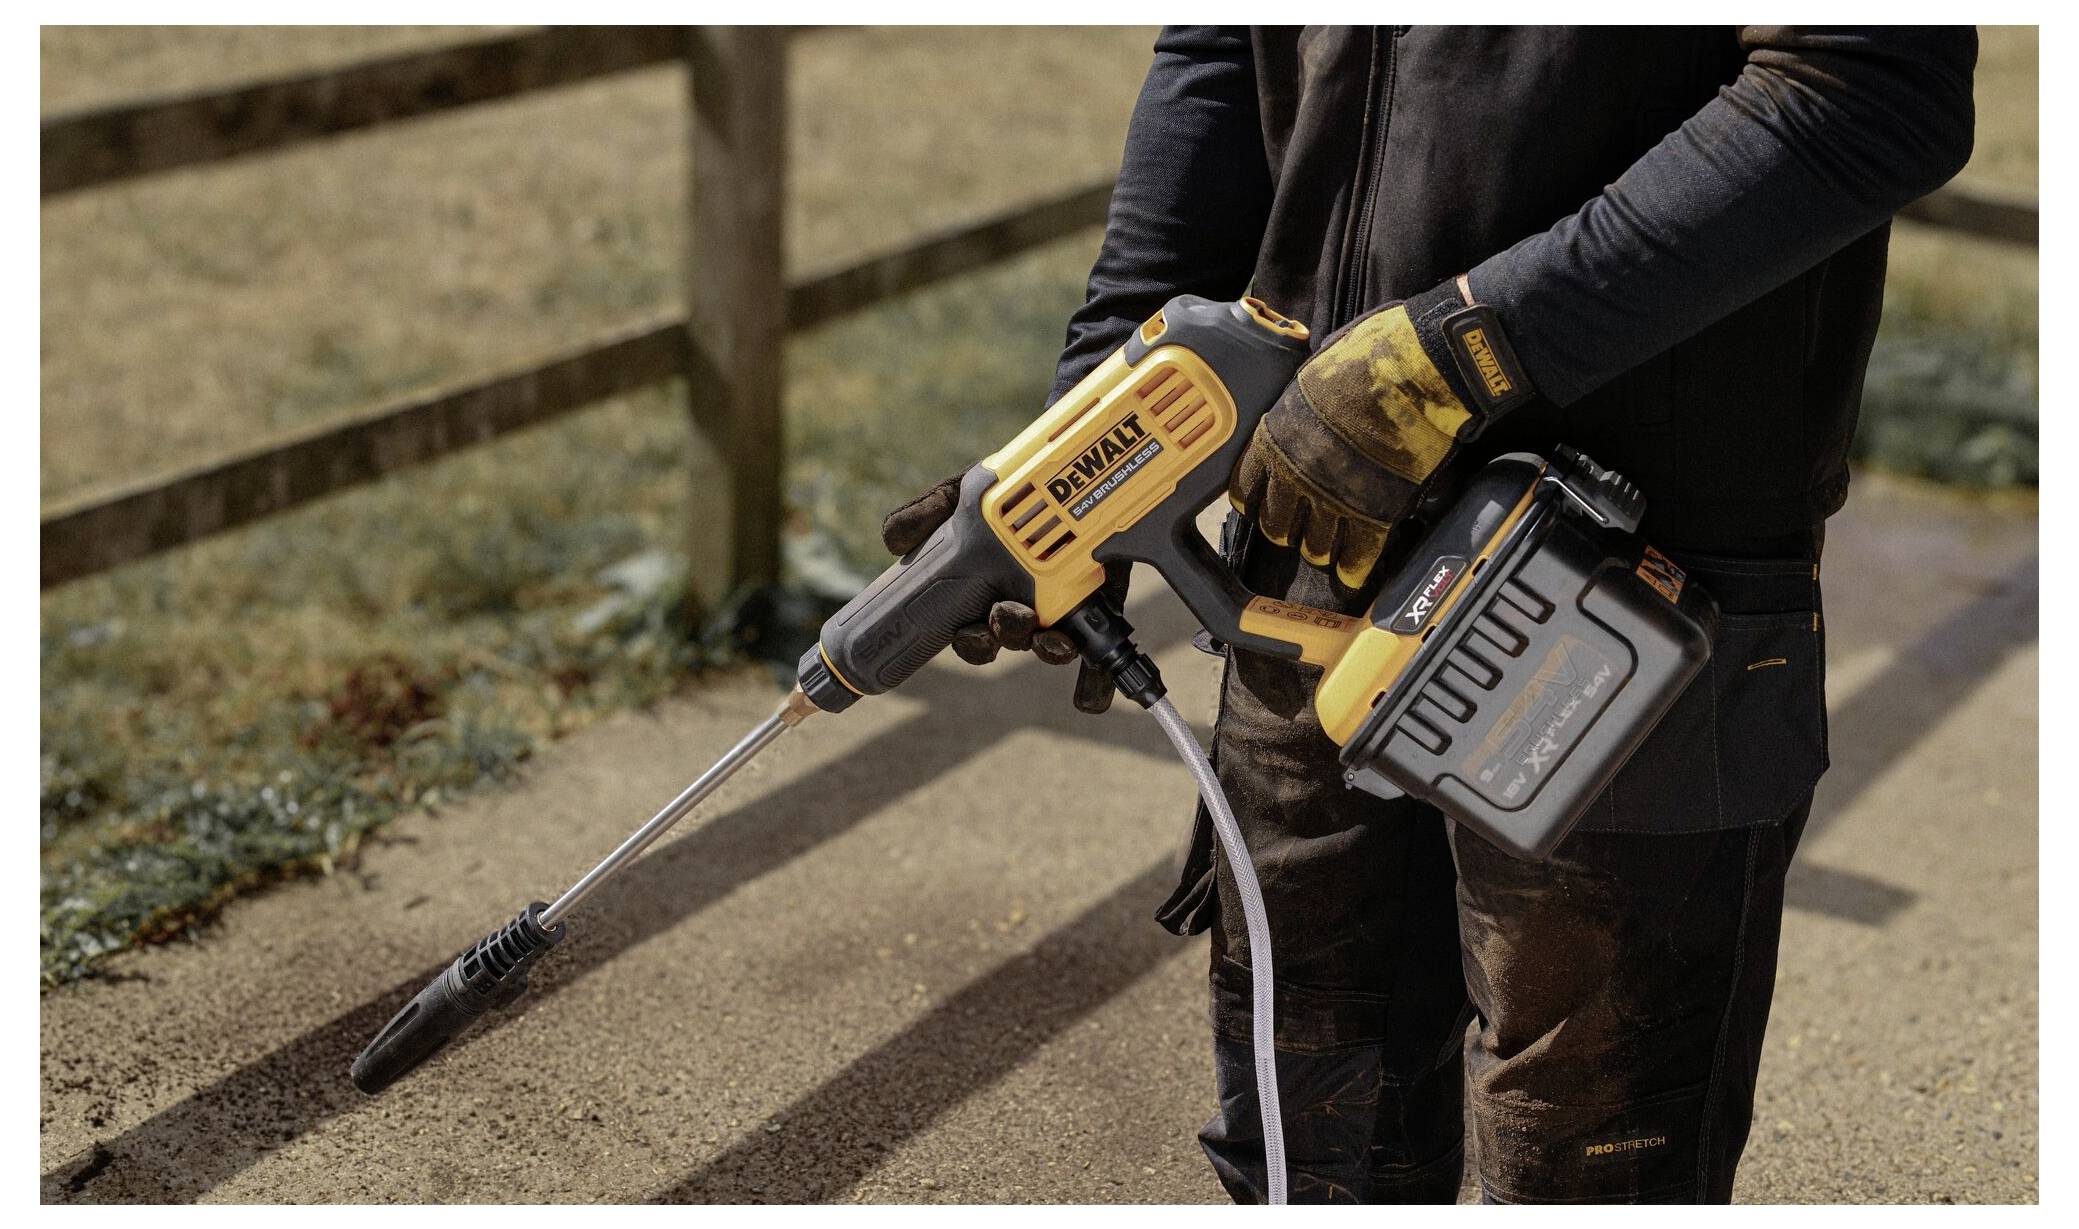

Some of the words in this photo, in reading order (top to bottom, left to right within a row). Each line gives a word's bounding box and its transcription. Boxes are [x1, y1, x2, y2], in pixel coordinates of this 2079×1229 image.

[1072, 497, 1094, 516] 54V
[1093, 441, 1160, 500] BRUSHLESS
[1402, 596, 1433, 625] XR
[1423, 565, 1450, 597] FLEX
